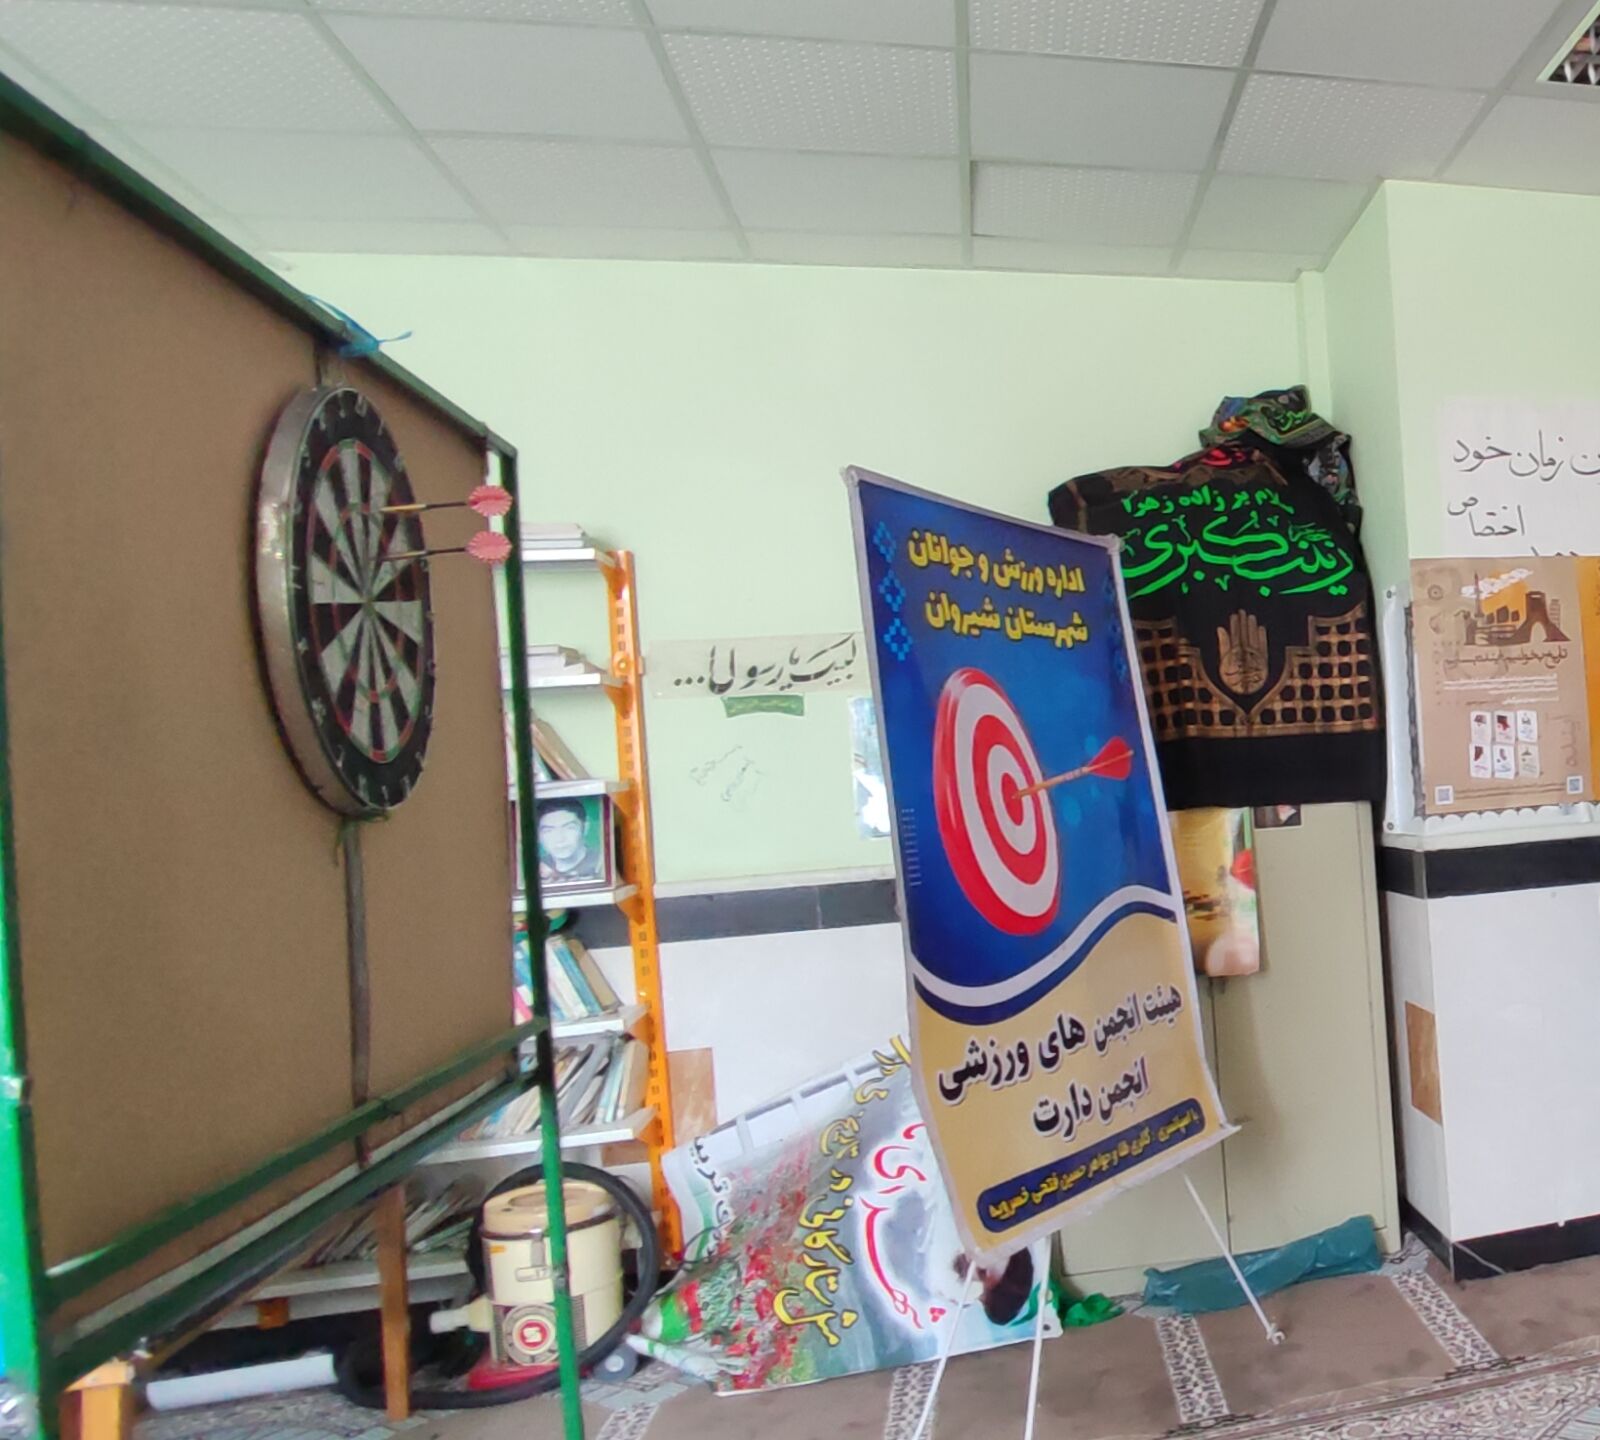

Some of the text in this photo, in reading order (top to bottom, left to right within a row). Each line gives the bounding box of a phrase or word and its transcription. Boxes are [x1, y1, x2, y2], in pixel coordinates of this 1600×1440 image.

[1453, 436, 1512, 472] خود
[1509, 429, 1564, 482] زمان
[1231, 490, 1251, 511] بر
[1255, 488, 1295, 514] لام
[1447, 496, 1526, 536] اختصاص
[908, 529, 1086, 599] اداره ورزش و جوانان
[925, 591, 1089, 649] شهرستان شیروان
[1095, 992, 1141, 1052] انجمن
[1143, 985, 1182, 1024] هیئت
[1039, 1013, 1086, 1069] های
[938, 1039, 1030, 1101] ورزشی
[1033, 1056, 1149, 1138] انجمن دارت
[1030, 1172, 1060, 1204] فتحی
[1059, 1164, 1086, 1190] حسین
[772, 1286, 858, 1347] مثل
[829, 1167, 853, 1192] در
